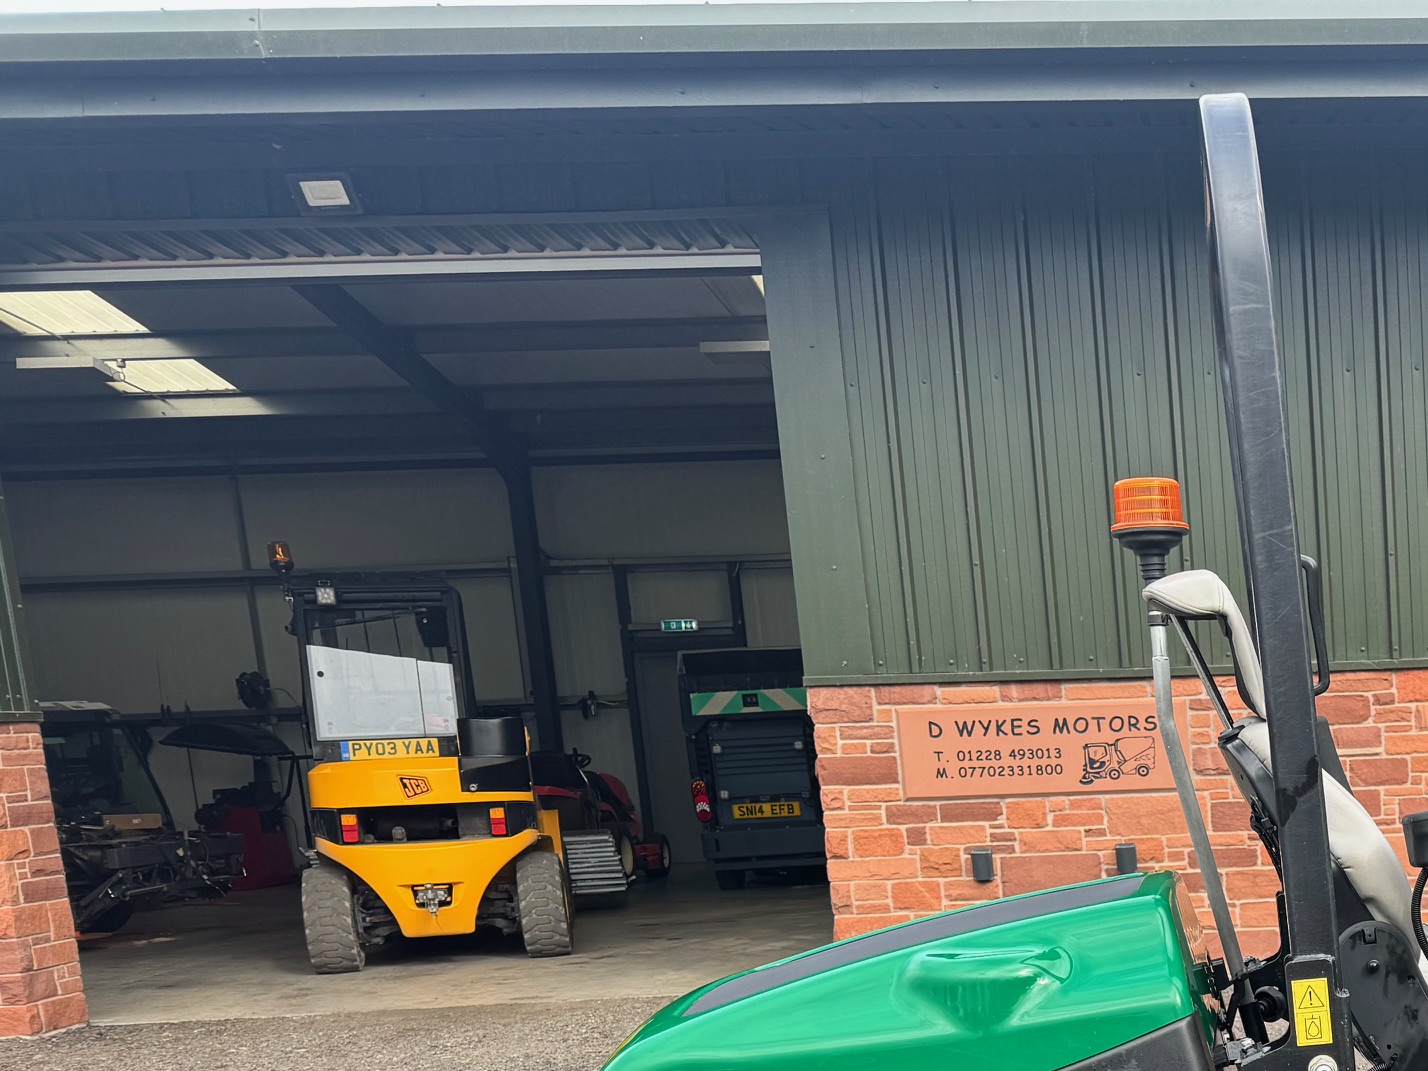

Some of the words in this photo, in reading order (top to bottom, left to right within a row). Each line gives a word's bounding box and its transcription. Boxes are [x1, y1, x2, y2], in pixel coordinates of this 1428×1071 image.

[928, 720, 943, 738] D
[954, 717, 1041, 737] WYKES
[1052, 715, 1158, 735] MOTORS
[351, 741, 398, 757] PY03
[402, 739, 436, 755] YAA
[933, 751, 950, 763] T.
[956, 749, 1003, 763] 01228
[1008, 747, 1063, 761] 493013
[935, 767, 955, 779] M.
[958, 763, 1064, 779] 07702331800
[401, 777, 430, 798] JCB
[737, 805, 766, 818] SN14
[770, 803, 796, 816] EFB
